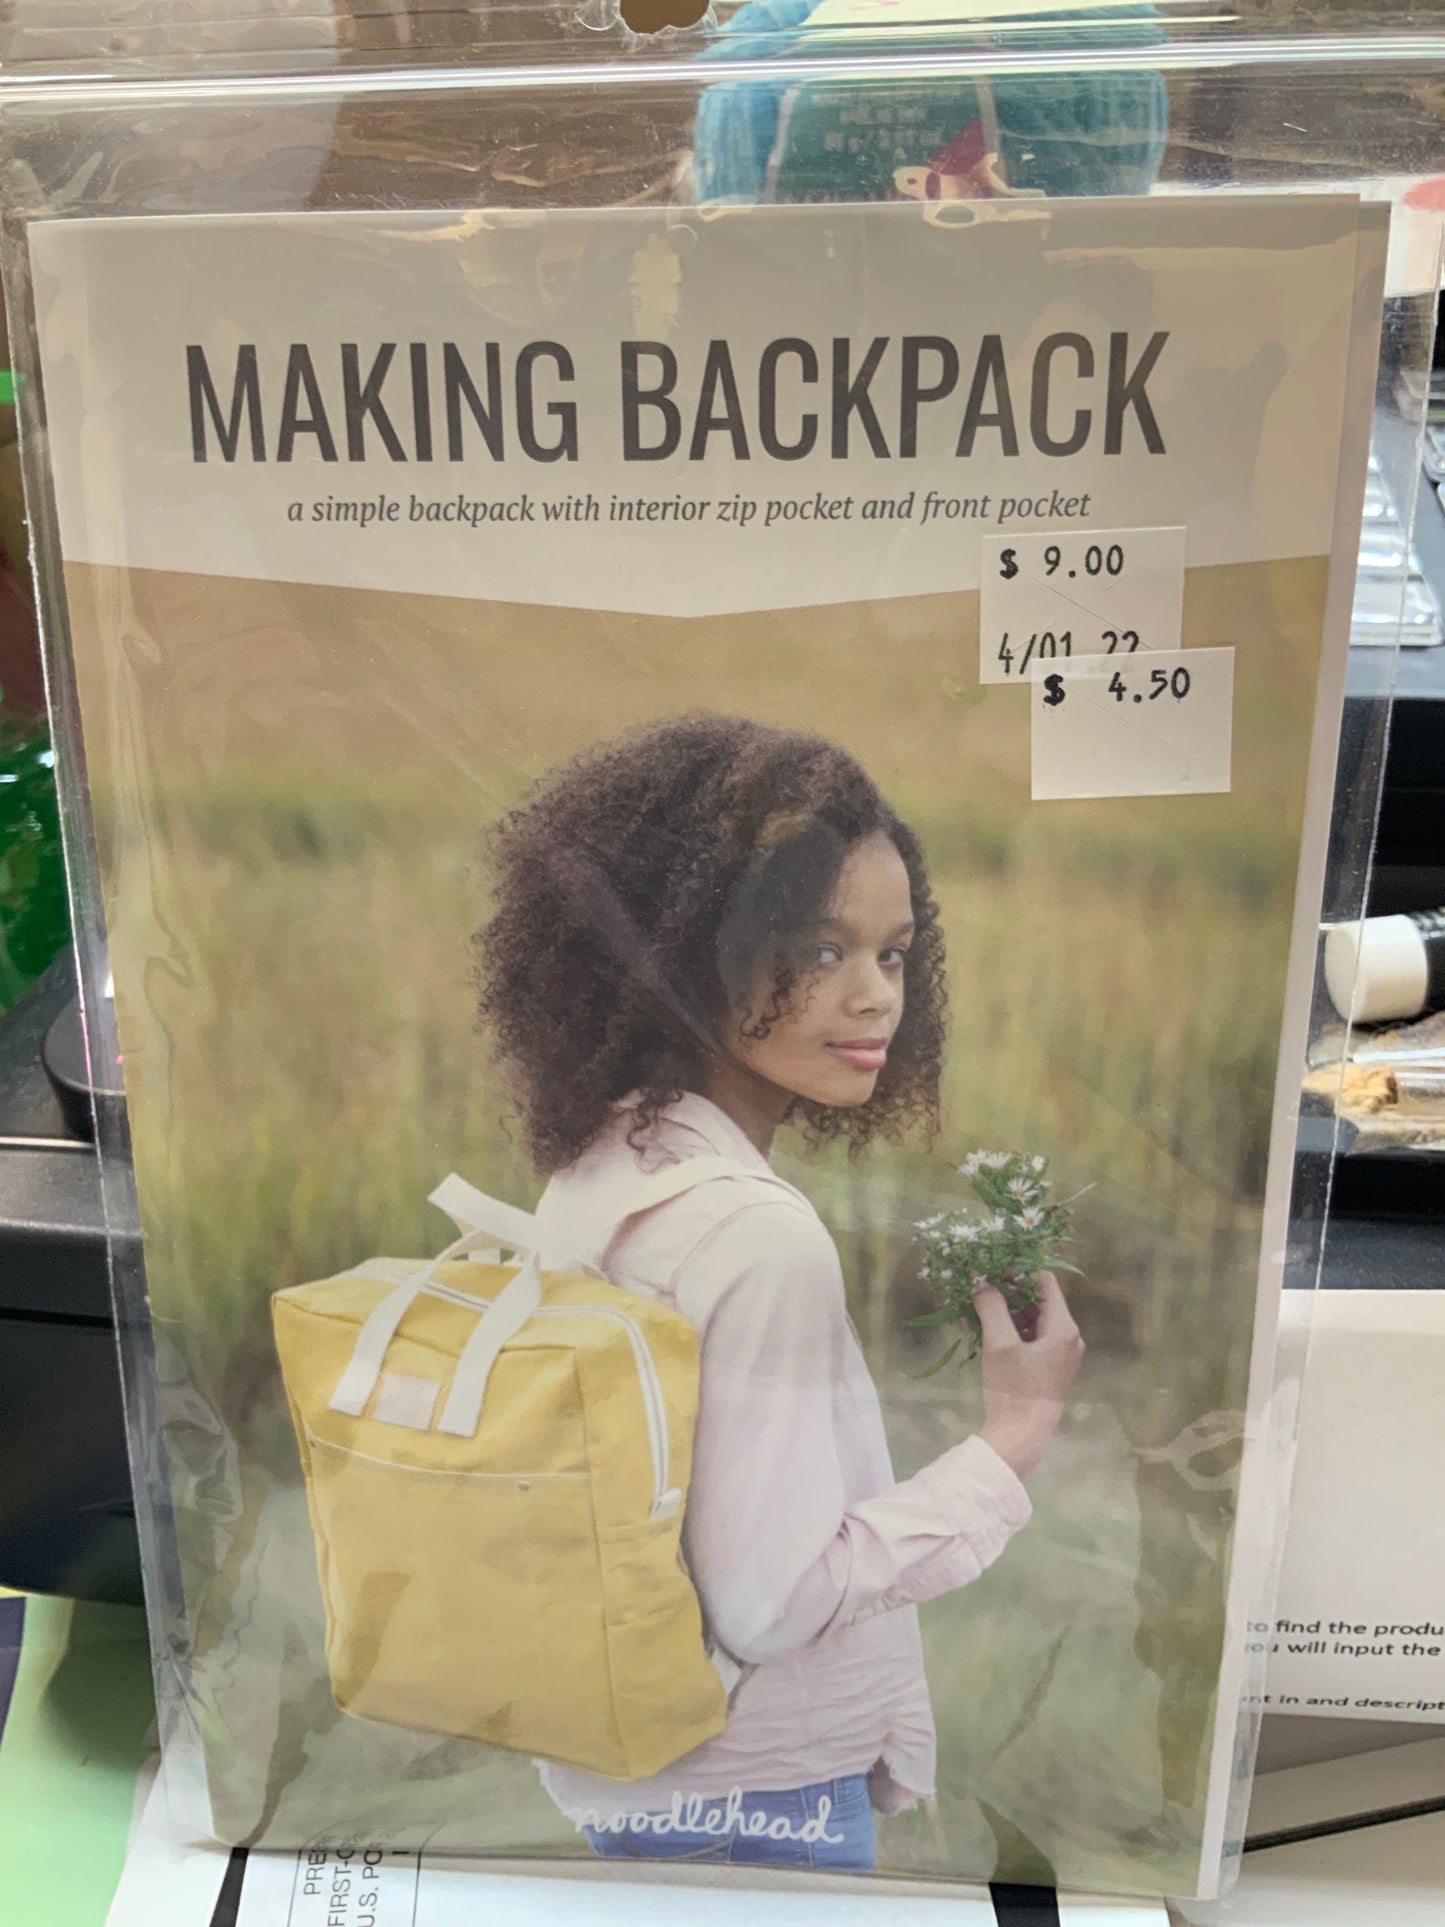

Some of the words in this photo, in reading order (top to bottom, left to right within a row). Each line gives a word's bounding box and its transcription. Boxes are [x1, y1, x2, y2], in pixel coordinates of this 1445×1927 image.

[186, 341, 578, 463] MAKING
[621, 332, 1169, 461] BACKPACK
[288, 502, 303, 521] a
[312, 495, 400, 528] simple
[409, 494, 535, 528] backpack
[542, 494, 600, 521] with
[610, 494, 711, 521] interior
[716, 494, 757, 527] zip
[765, 492, 854, 527] pocket
[862, 491, 915, 520] and
[920, 490, 991, 525] front
[997, 489, 1091, 524] pocket
[1000, 549, 1018, 579] $
[1044, 545, 1124, 579] 9.00
[1043, 674, 1066, 706] $
[1108, 667, 1191, 703] 4.50
[1276, 1620, 1321, 1634] find
[1328, 1621, 1367, 1635] the
[1374, 1622, 1445, 1638] produ
[1287, 1641, 1326, 1654] will
[1334, 1642, 1394, 1657] input
[1402, 1643, 1441, 1656] the
[1280, 1695, 1299, 1704] in
[1307, 1696, 1349, 1706] and
[562, 1786, 844, 1844] noodlehead
